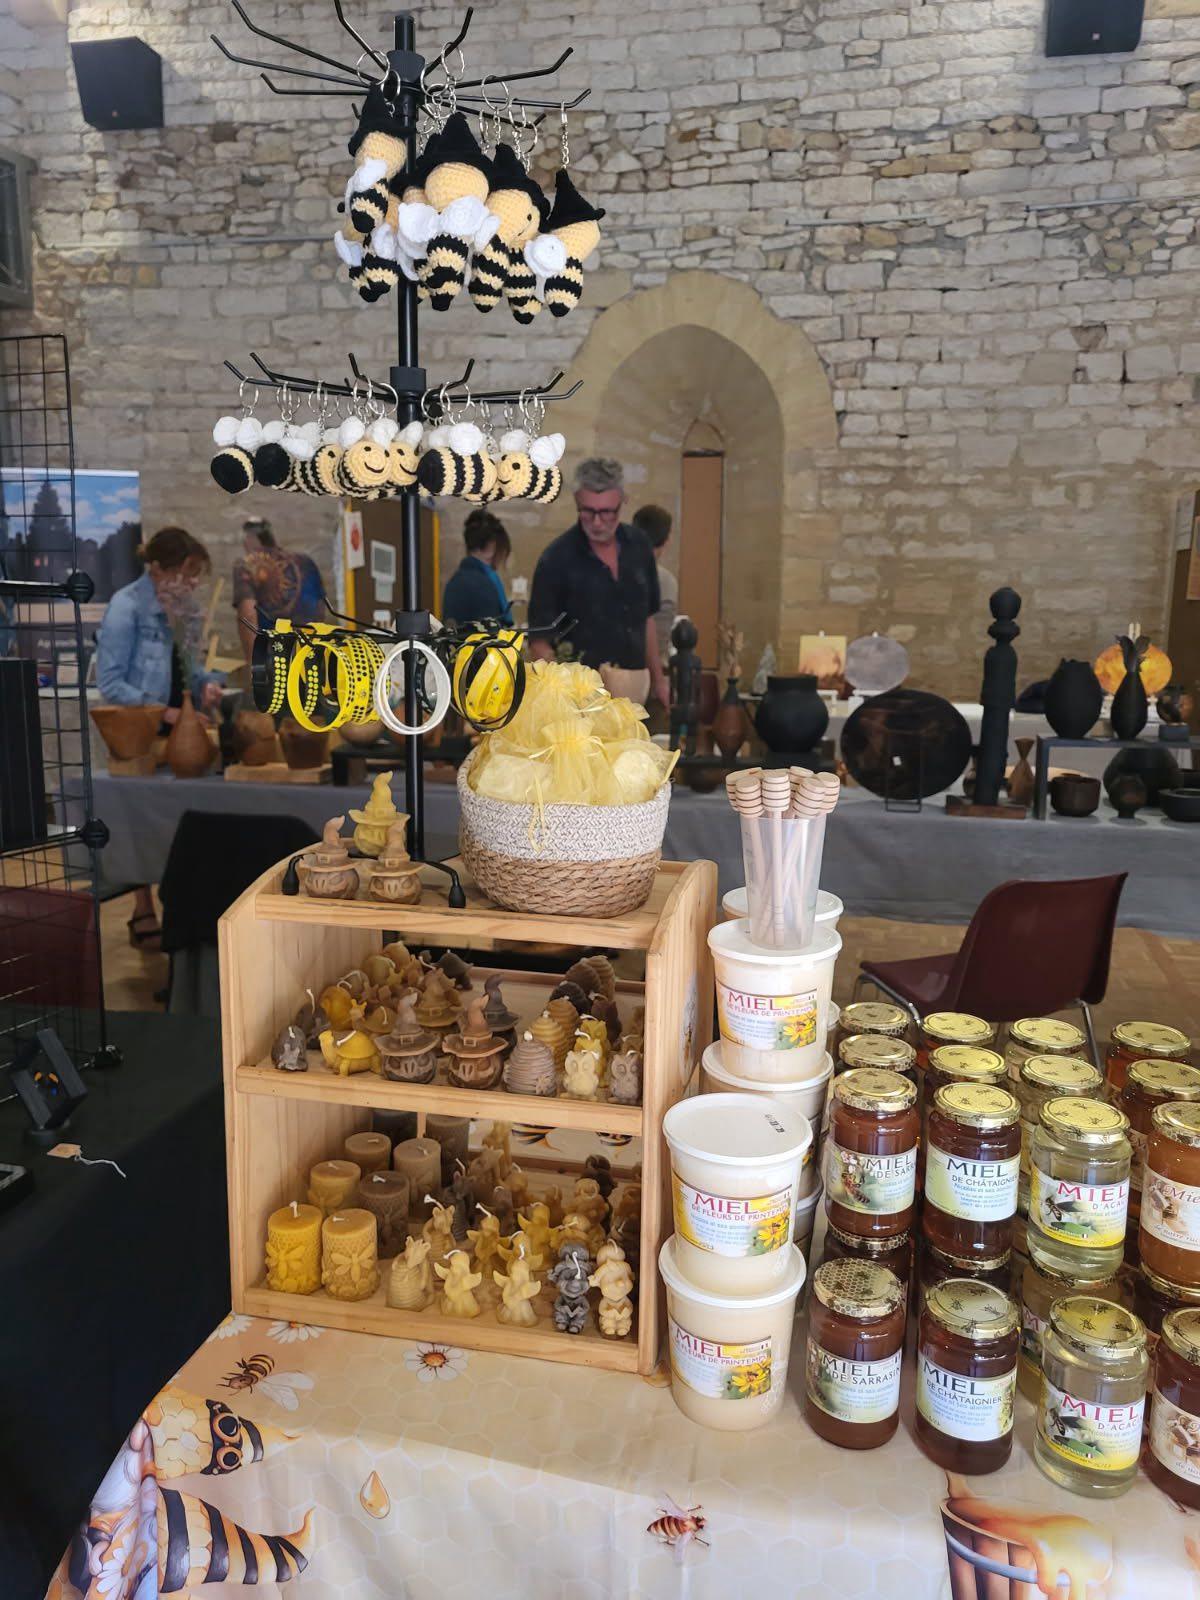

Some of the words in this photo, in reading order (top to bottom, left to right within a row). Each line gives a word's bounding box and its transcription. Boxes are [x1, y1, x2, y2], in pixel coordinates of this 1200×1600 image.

[728, 991, 782, 1011] MIEL
[865, 1154, 912, 1171] MIEL
[947, 1158, 1008, 1179] MIEL
[876, 1170, 890, 1179] DE
[951, 1174, 963, 1184] DE
[1057, 1182, 1126, 1202] MIEL
[691, 1204, 701, 1213] DE
[702, 1207, 732, 1221] FLEURS
[734, 1213, 746, 1222] DE
[694, 1192, 758, 1215] MIEL
[676, 1327, 732, 1359] MIEL
[708, 1356, 719, 1364] DE
[822, 1354, 878, 1377] MIEL
[832, 1370, 848, 1382] DE
[923, 1359, 985, 1396] MIEL
[926, 1378, 937, 1391] DE
[937, 1386, 1002, 1406] CHÂTAIGNIER
[1061, 1393, 1138, 1424] MIEL
